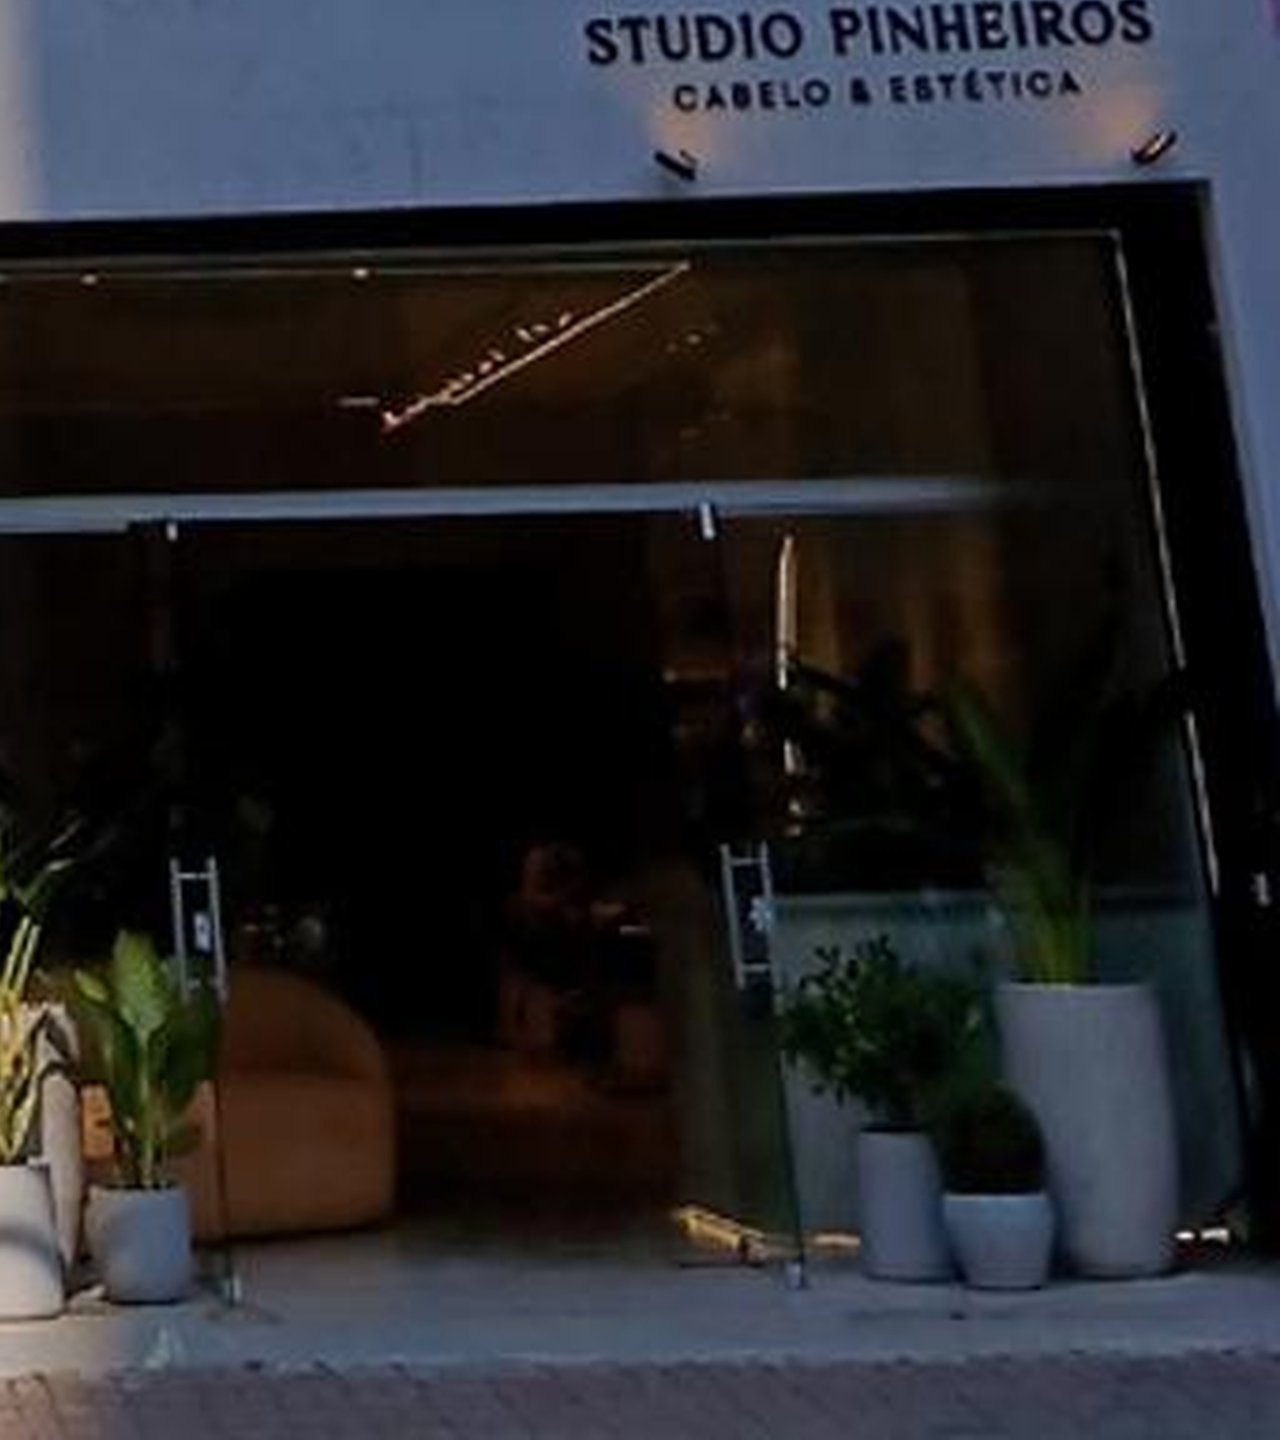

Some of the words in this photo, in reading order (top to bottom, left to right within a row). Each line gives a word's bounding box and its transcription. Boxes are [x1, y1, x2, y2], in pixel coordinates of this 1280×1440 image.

[584, 11, 805, 67] STUDIO
[672, 79, 831, 113] CABELO
[889, 67, 1083, 105] ESTÉTICA
